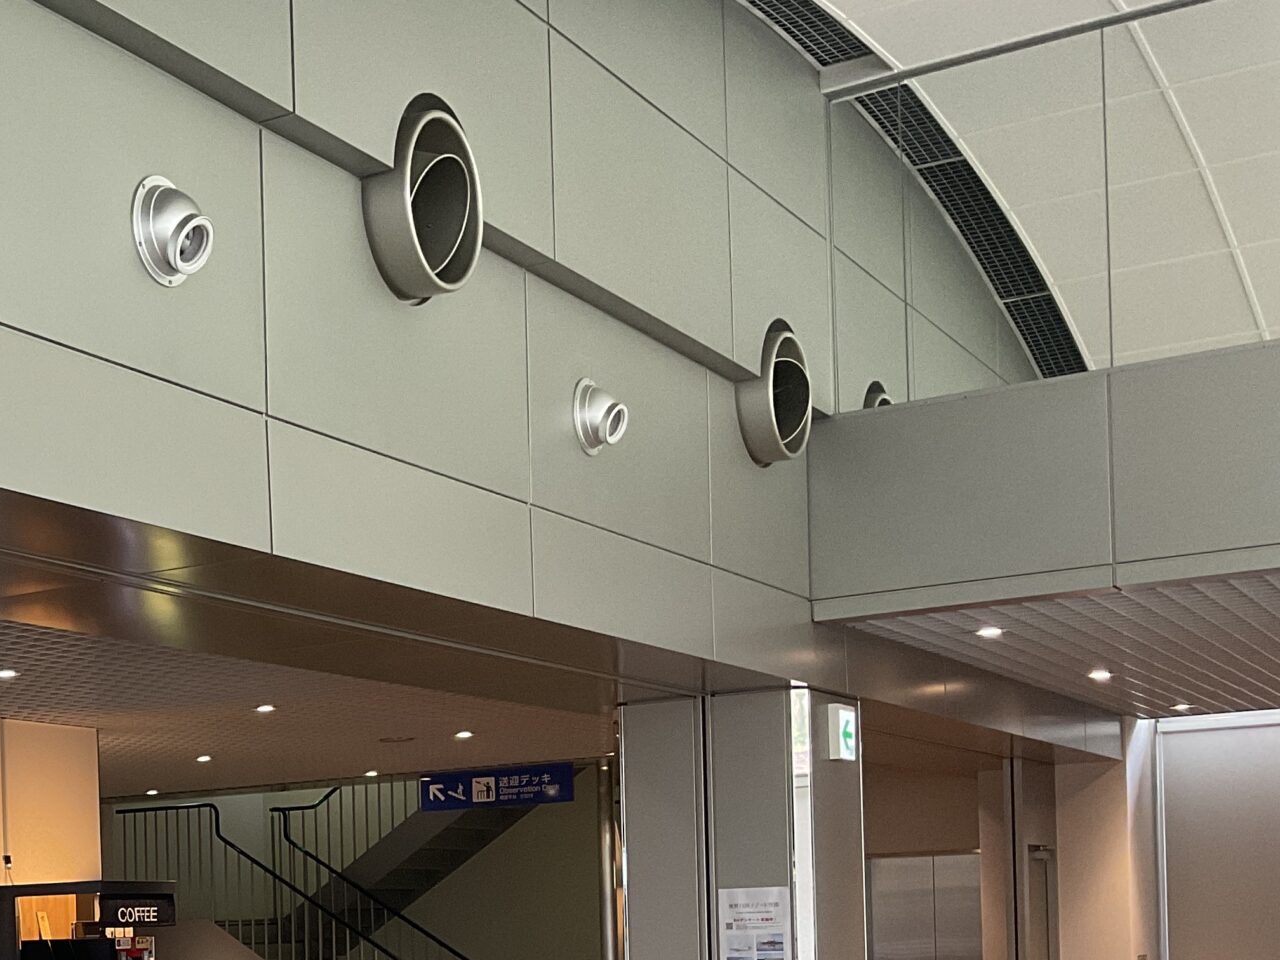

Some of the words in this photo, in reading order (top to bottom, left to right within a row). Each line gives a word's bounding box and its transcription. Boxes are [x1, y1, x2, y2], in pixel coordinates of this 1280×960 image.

[499, 773, 551, 787] 送迎デッキ
[499, 785, 541, 794] Observation
[117, 907, 158, 923] COFFEE
